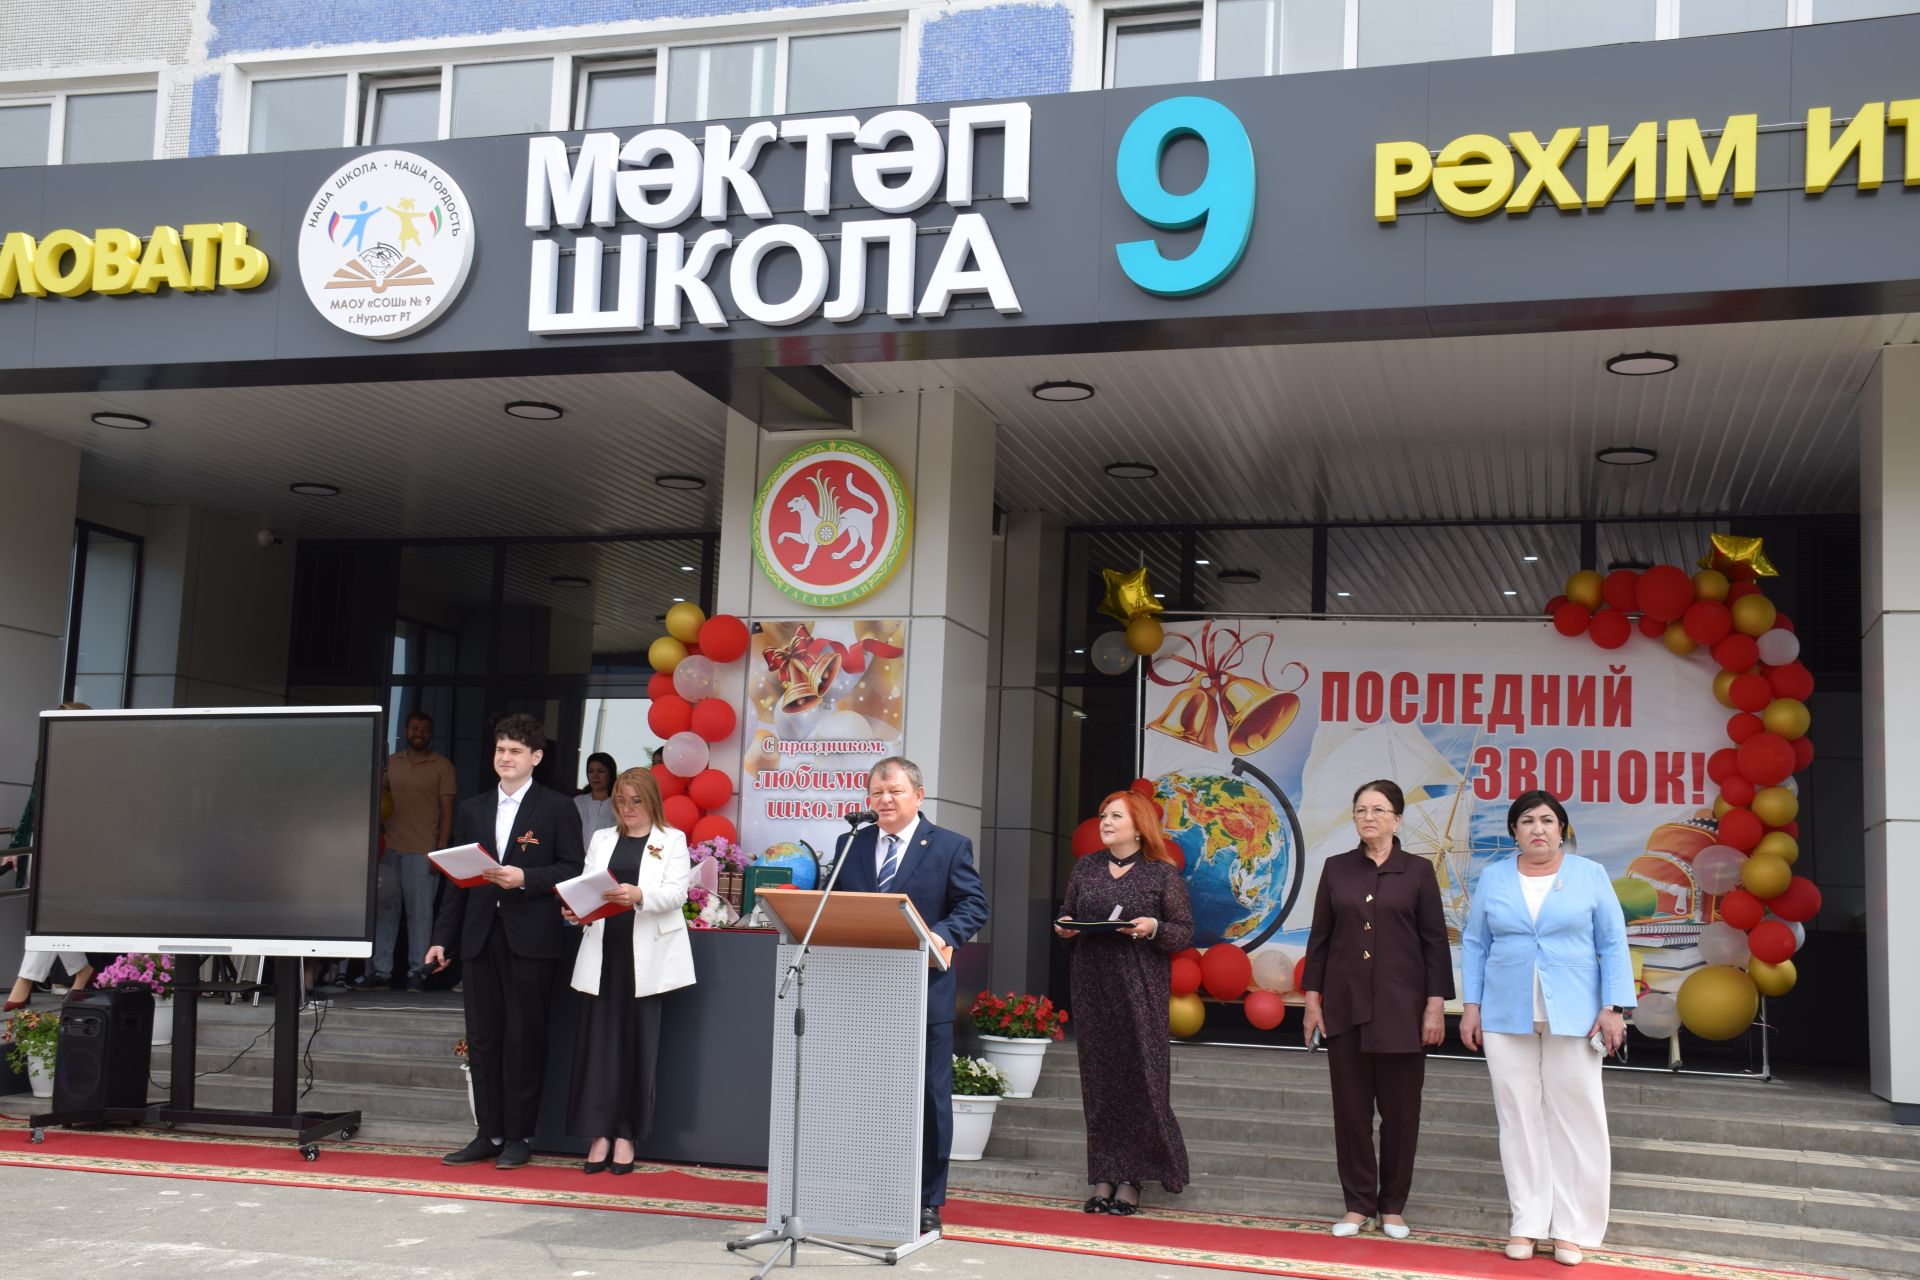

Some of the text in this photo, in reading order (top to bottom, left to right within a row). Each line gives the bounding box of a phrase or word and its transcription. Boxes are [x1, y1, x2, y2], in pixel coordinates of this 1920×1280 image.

[308, 191, 335, 228] НАША
[335, 161, 378, 190] ШКОЛА
[394, 159, 428, 180] НАША
[428, 175, 461, 237] ГОРДОСТЬ
[526, 102, 1031, 231] МӘКТӘП
[1115, 96, 1256, 297] 9
[1375, 114, 1758, 223] РӘХИМ
[0, 222, 269, 299] ЛОВАТЬ
[528, 212, 1022, 336] ШКОЛА
[330, 299, 365, 310] МАОУ
[410, 296, 422, 306] №
[425, 295, 432, 306] 9
[399, 311, 412, 322] РТ
[783, 584, 869, 605] ТАТАРСТАН
[1320, 664, 1633, 735] ПОСЛЕДНИЙ
[754, 764, 869, 790] любима
[762, 737, 775, 753] С
[1473, 746, 1706, 805] ЗВОНОК!
